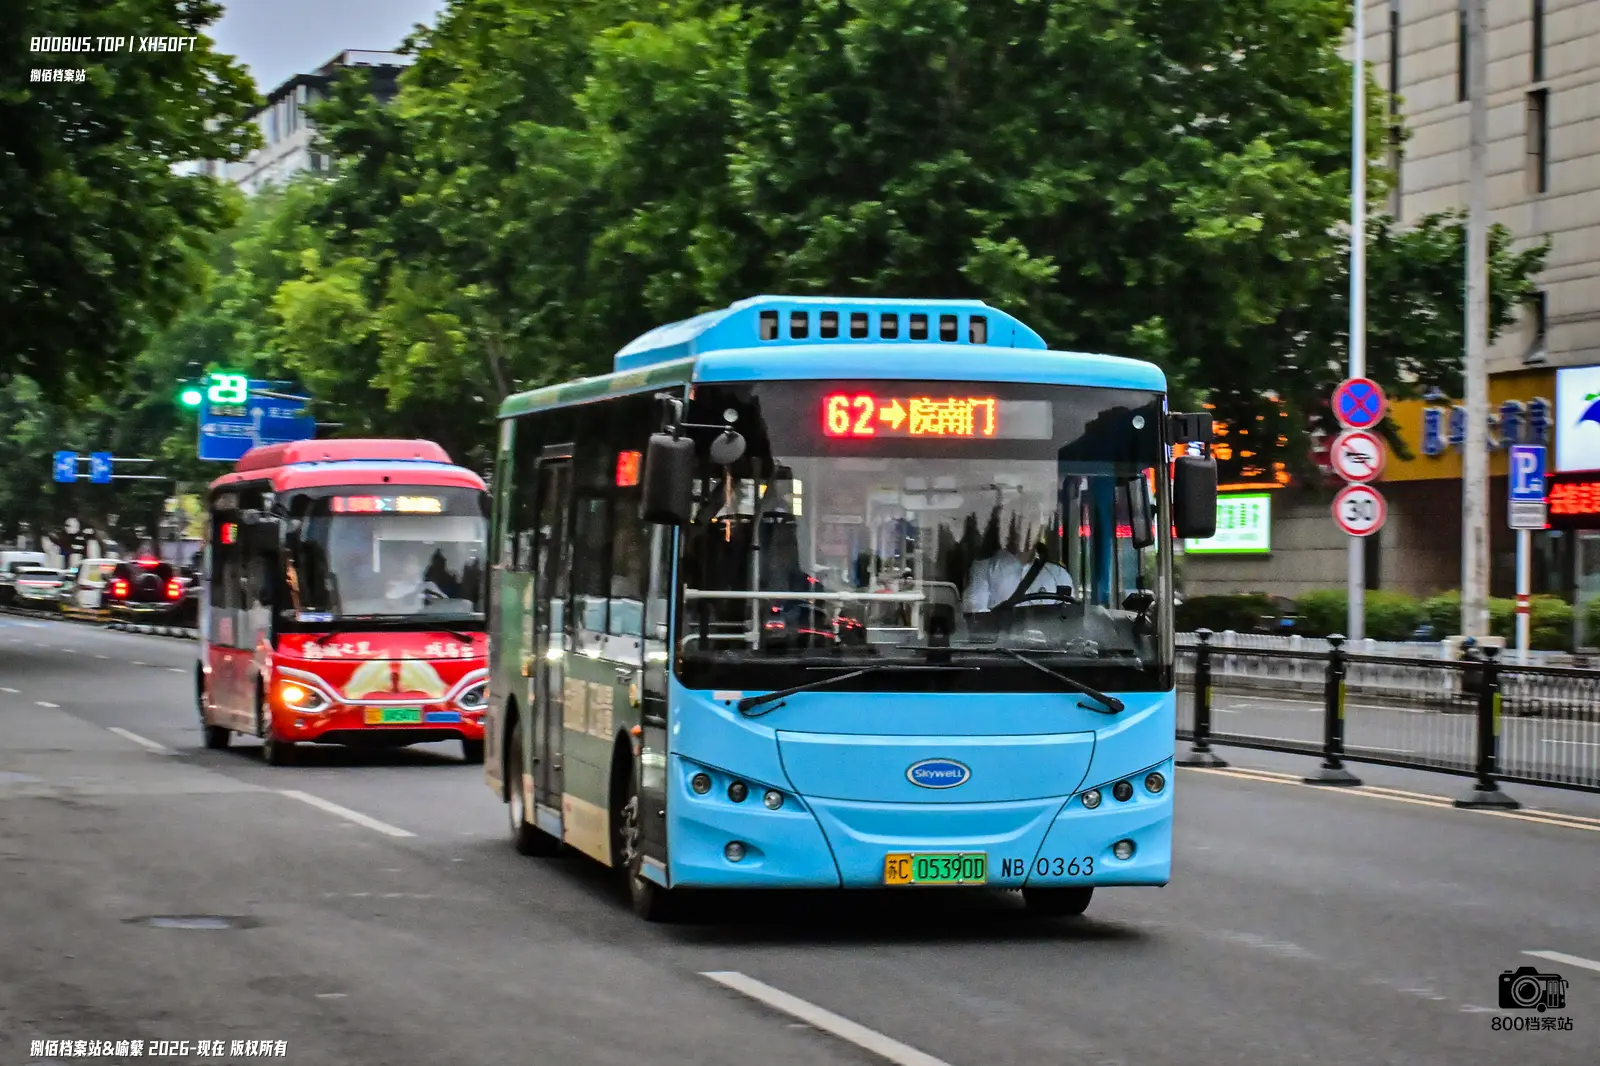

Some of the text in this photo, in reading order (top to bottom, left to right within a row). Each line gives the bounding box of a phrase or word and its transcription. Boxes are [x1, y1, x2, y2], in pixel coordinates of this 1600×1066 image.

[827, 395, 996, 436] 62 院南门
[1512, 451, 1539, 494] P
[1345, 498, 1376, 521] 30
[917, 858, 985, 880] 05390D
[1001, 855, 1094, 878] NB 0363
